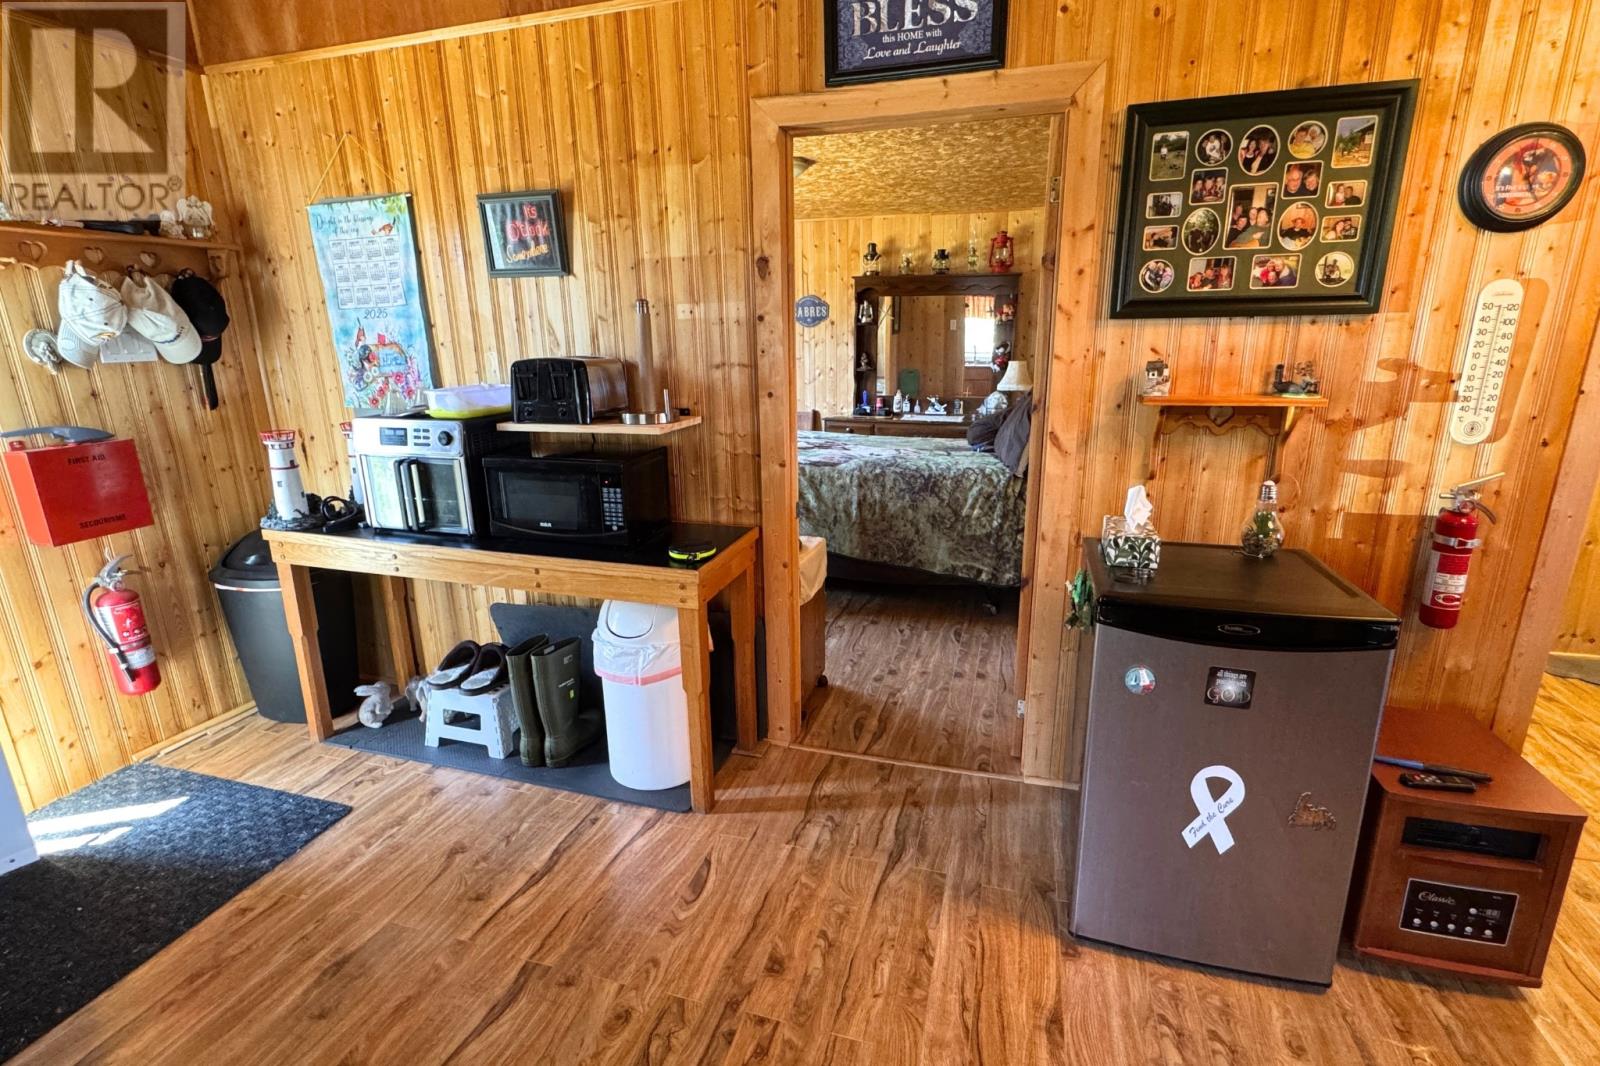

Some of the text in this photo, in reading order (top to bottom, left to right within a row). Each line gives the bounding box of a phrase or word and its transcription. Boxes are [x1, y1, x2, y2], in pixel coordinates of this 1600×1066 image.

[852, 0, 978, 36] BLESS
[882, 28, 942, 43] this HOME with
[863, 38, 962, 60] Love and Laughter
[797, 306, 827, 318] ABRES
[1482, 302, 1494, 310] 50
[1506, 303, 1520, 311] 120
[363, 308, 388, 320] 2025
[1501, 332, 1513, 340] 80
[1473, 340, 1485, 348] 20
[67, 456, 89, 465] FIRST
[1188, 797, 1234, 837] Find the Cure
[1418, 891, 1456, 905] Classic
